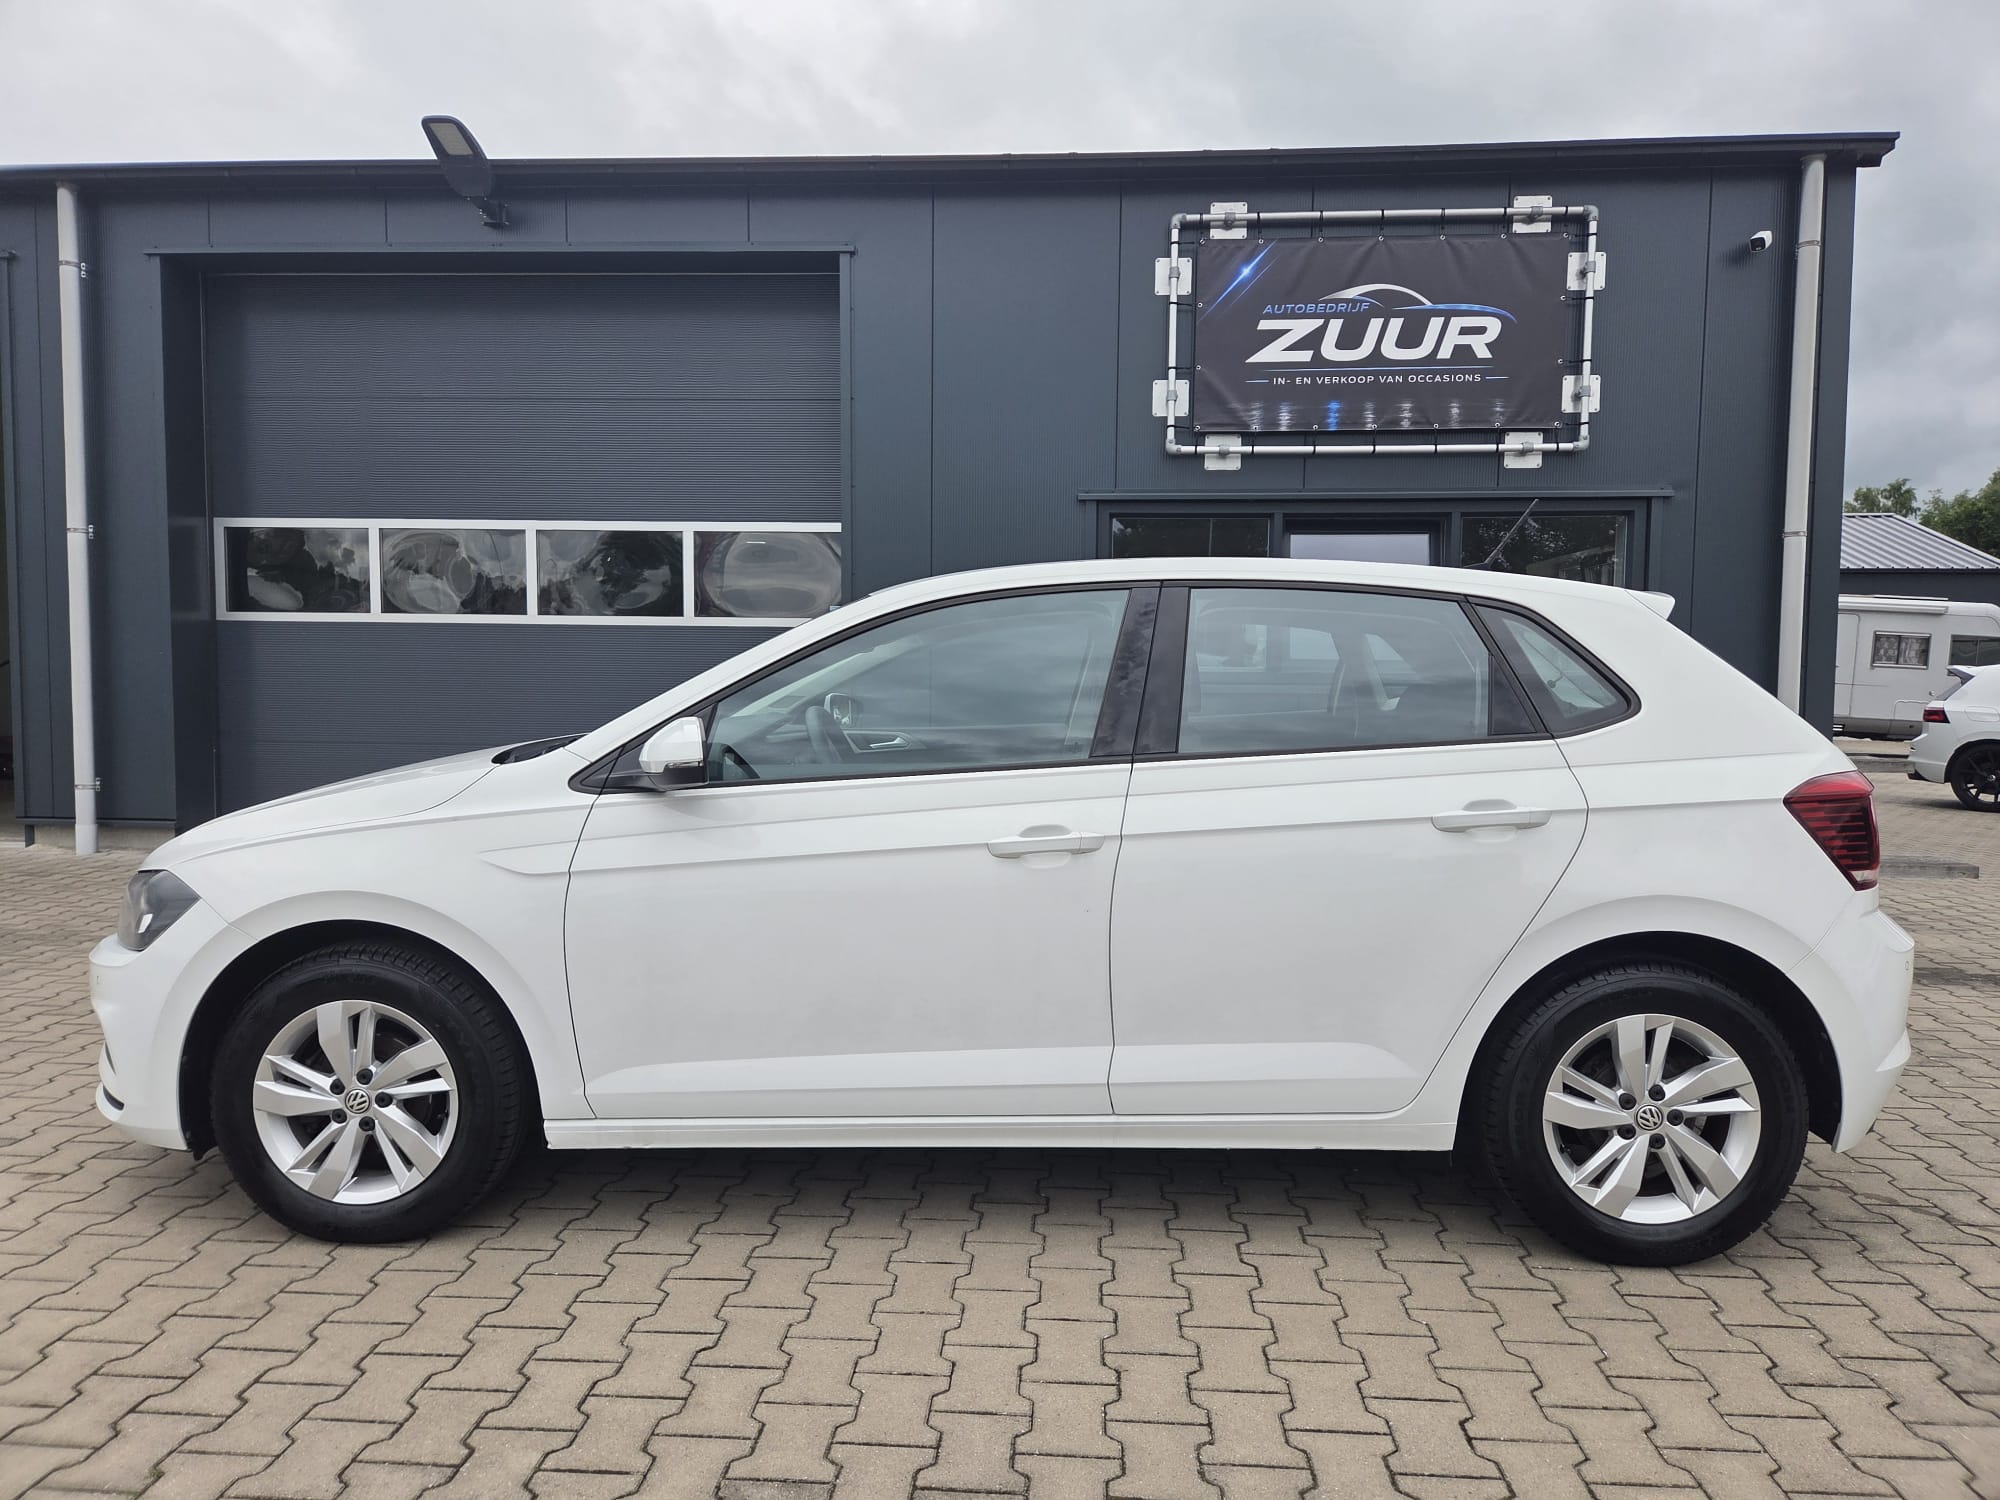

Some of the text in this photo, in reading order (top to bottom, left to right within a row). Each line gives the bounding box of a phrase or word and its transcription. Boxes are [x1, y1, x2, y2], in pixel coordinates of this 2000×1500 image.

[1263, 303, 1370, 314] AUTOBEDRIJF
[1245, 316, 1502, 363] ZUUR
[1273, 374, 1481, 386] IN- EN VERKOOP VAN OCCASIONS
[346, 1090, 370, 1113] VW
[1637, 1105, 1663, 1131] VW
